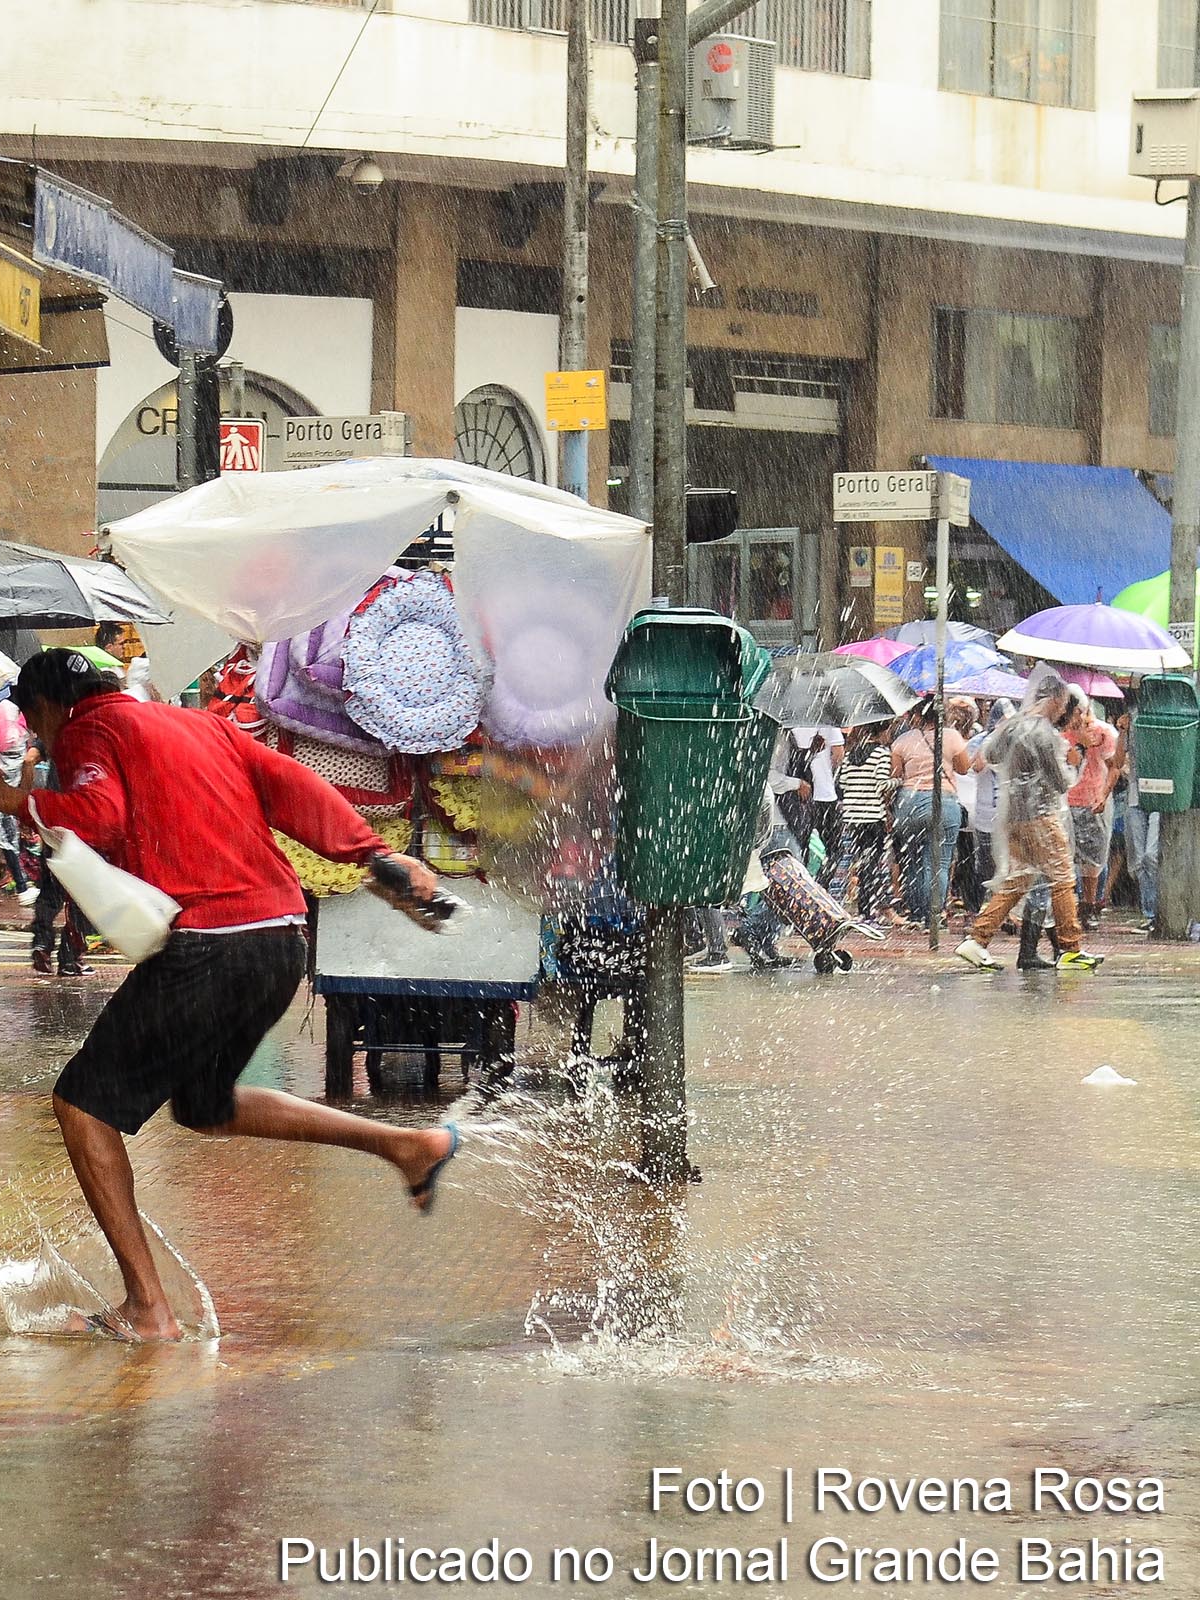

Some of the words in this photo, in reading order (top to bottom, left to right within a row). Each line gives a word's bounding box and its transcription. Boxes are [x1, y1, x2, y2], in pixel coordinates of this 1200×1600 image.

[286, 420, 333, 441] Porto
[341, 419, 383, 441] Gera
[837, 476, 880, 494] Porto
[887, 474, 931, 493] Geral
